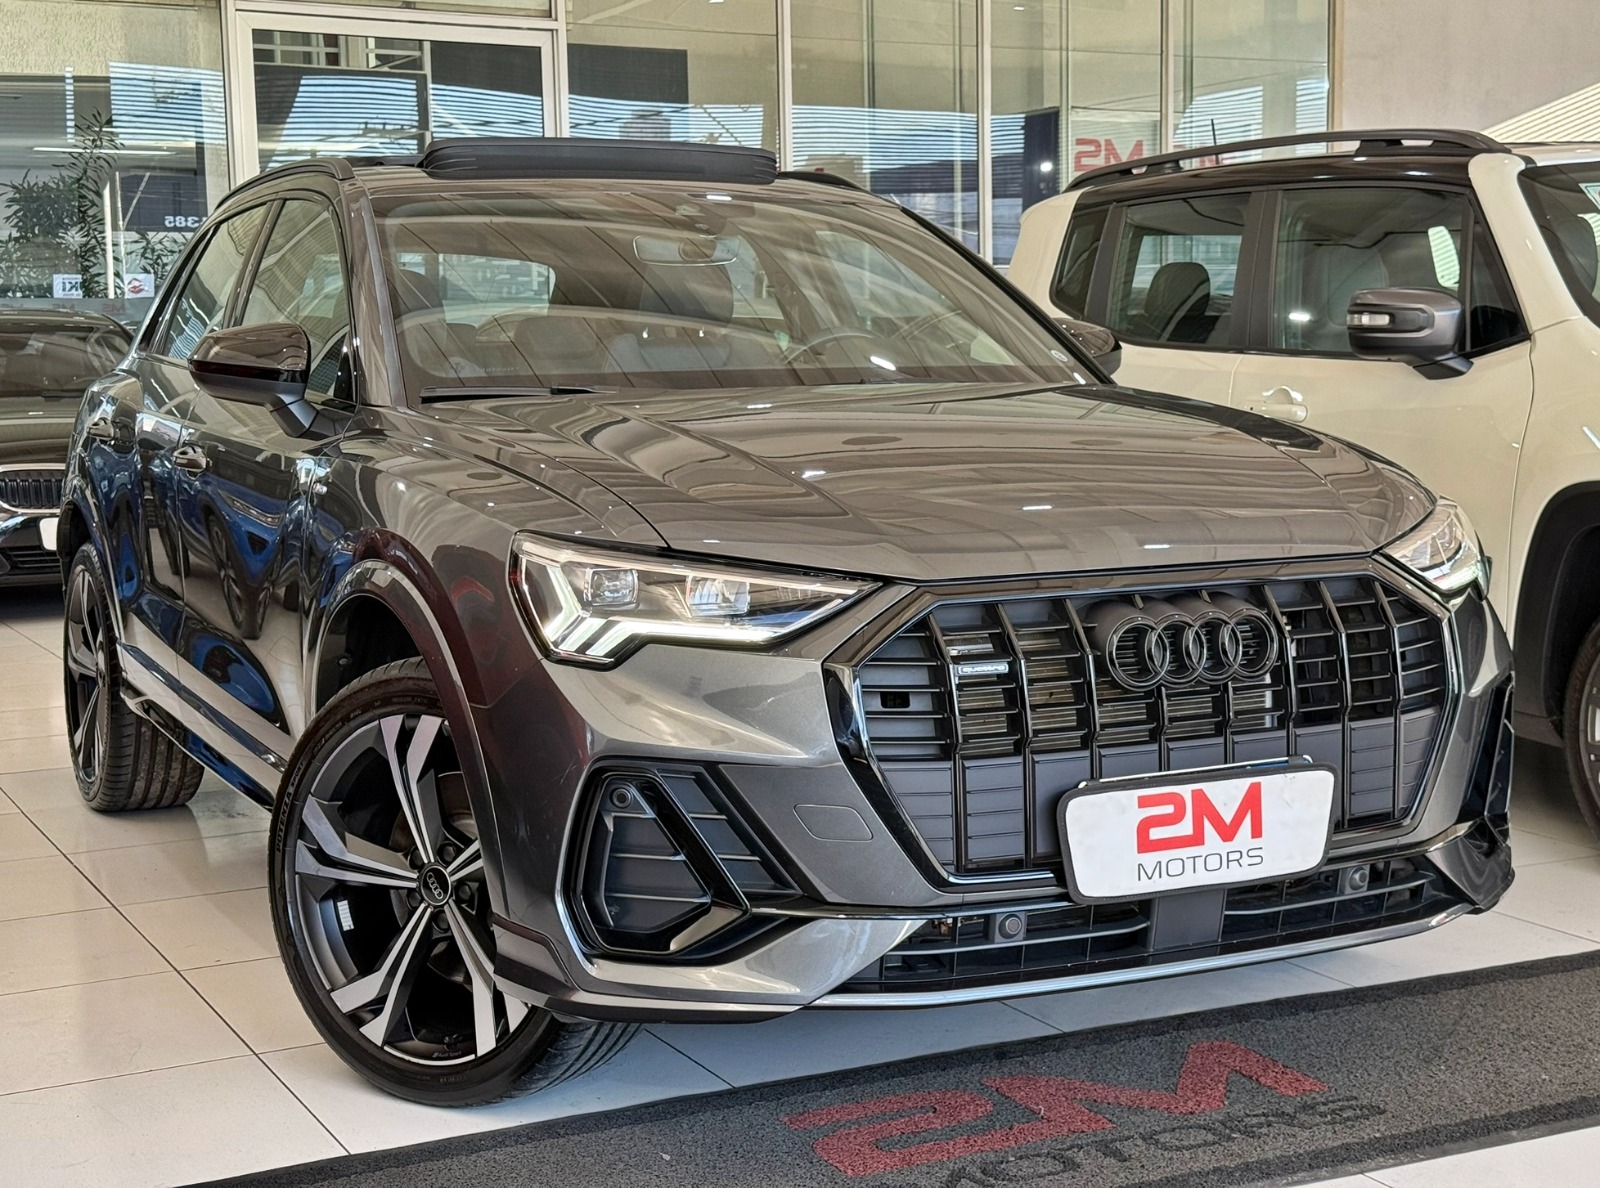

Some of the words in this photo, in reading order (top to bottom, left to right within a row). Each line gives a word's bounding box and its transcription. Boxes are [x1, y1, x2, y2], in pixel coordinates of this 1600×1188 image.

[1136, 781, 1263, 854] 2M
[1136, 846, 1264, 882] MOTORS
[780, 1040, 1329, 1177] 2M
